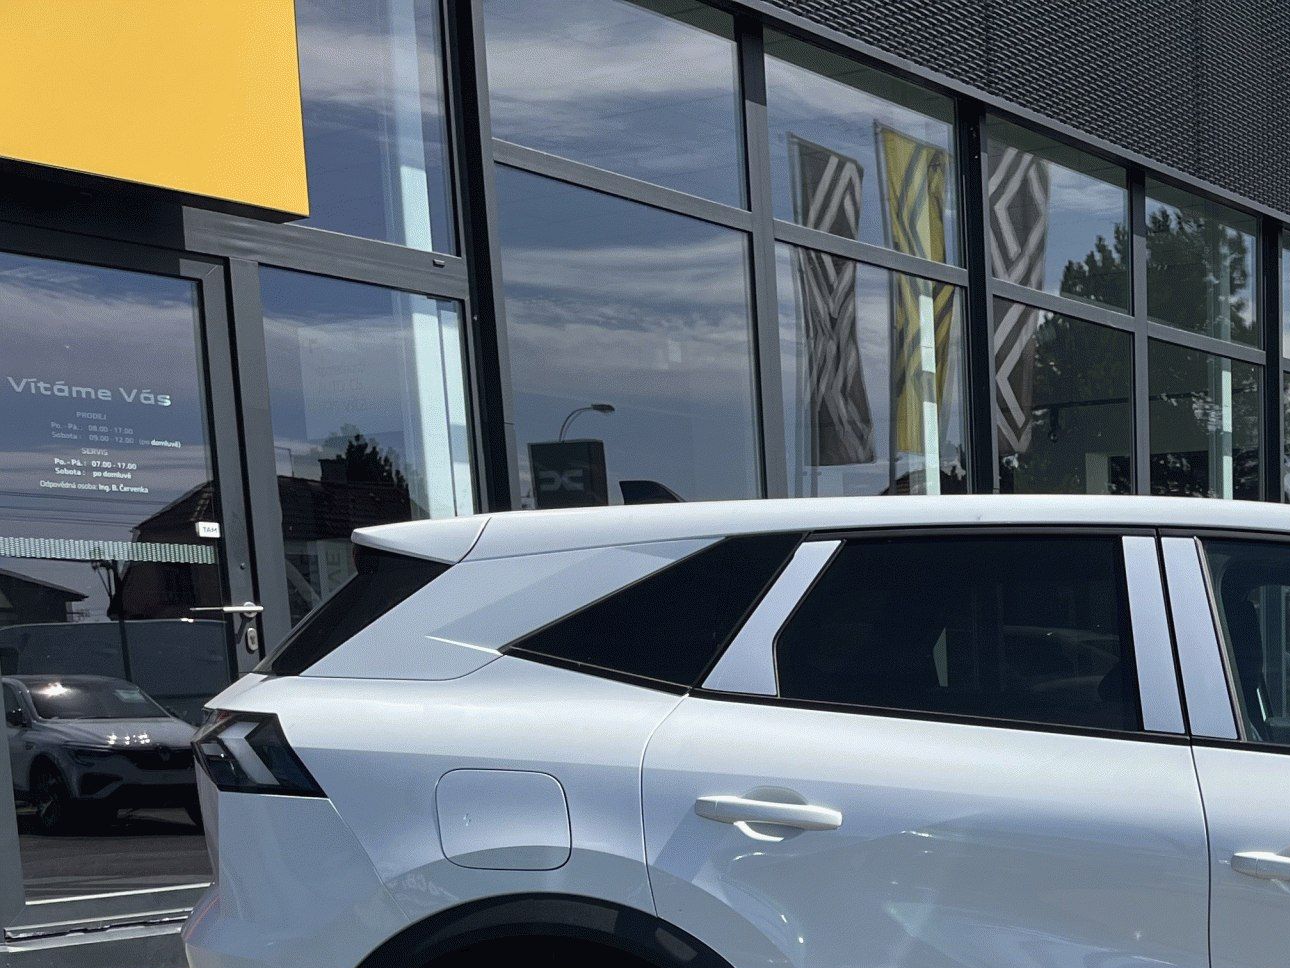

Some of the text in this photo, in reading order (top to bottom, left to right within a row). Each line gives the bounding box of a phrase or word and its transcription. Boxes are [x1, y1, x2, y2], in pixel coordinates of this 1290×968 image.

[7, 376, 172, 407] Vítáme Vás
[91, 460, 112, 468] 07.00
[117, 462, 137, 470] 17.00
[54, 467, 82, 476] Sobota
